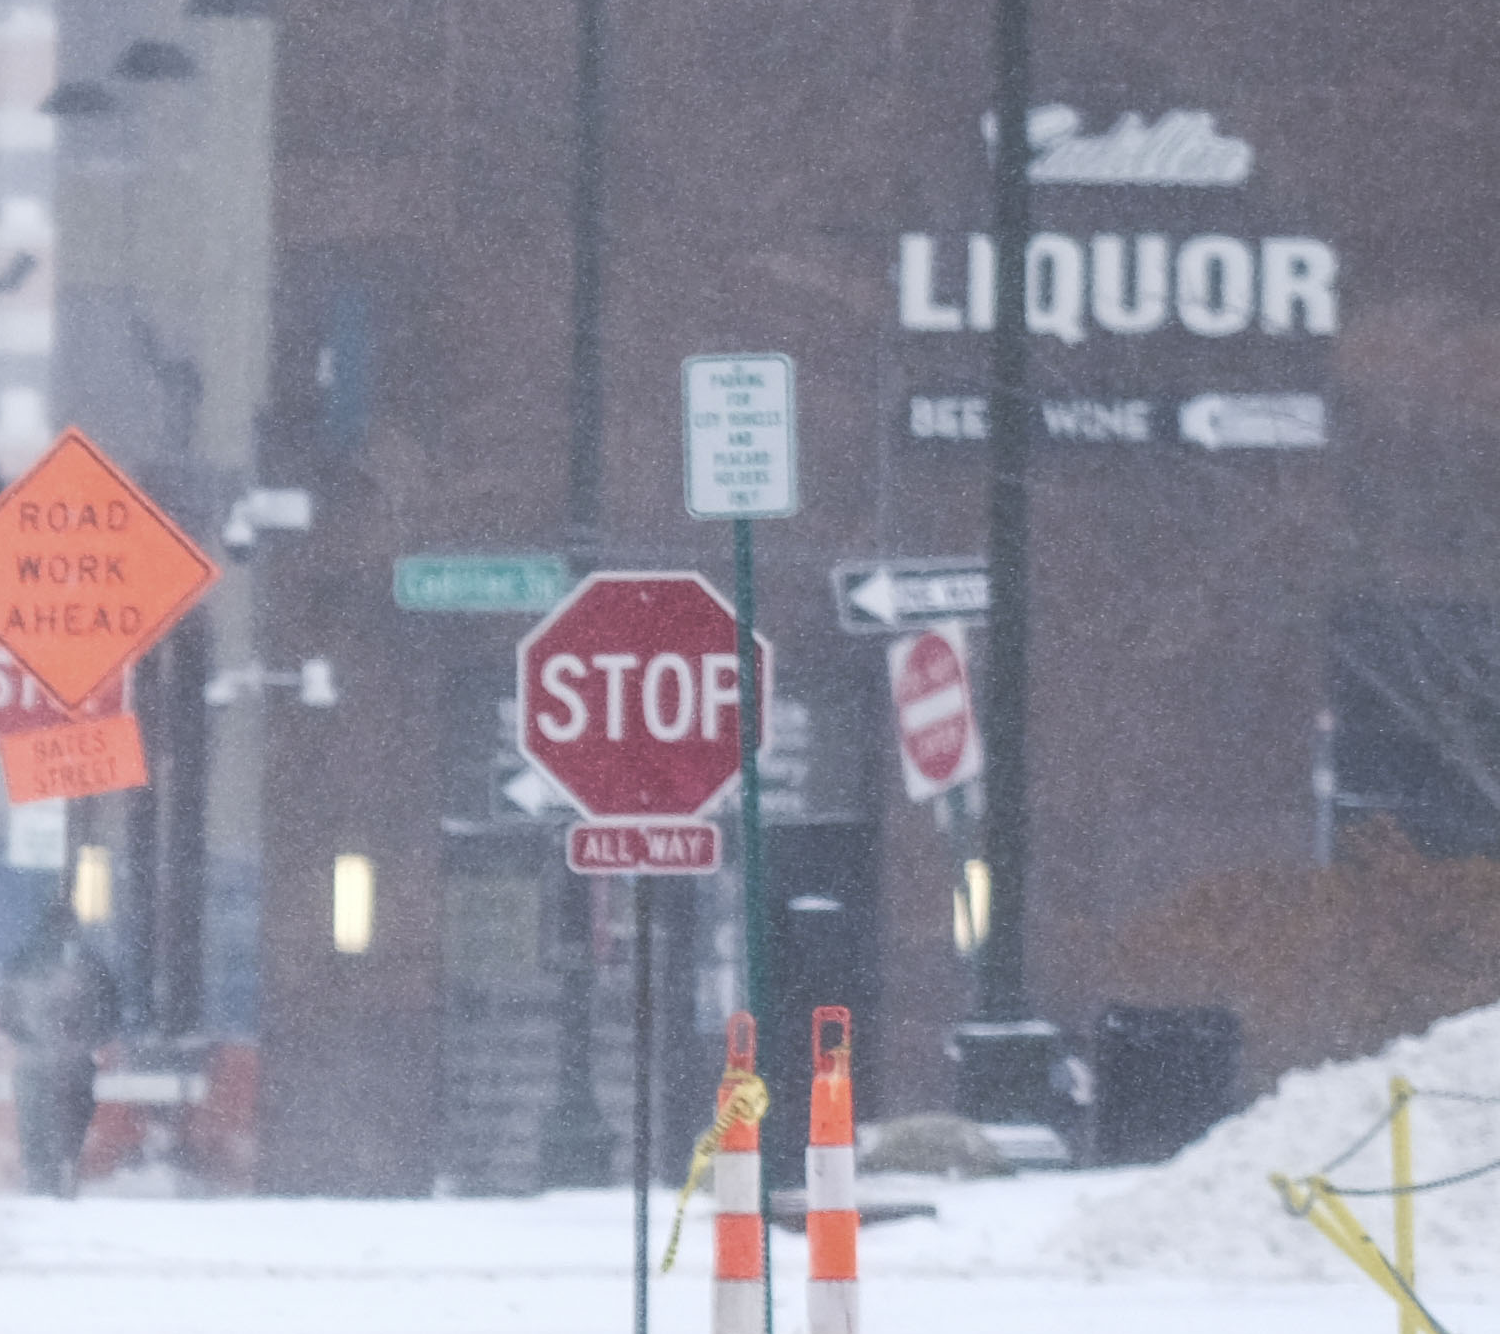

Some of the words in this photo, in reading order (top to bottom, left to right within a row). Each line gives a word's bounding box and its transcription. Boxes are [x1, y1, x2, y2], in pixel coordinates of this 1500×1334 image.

[902, 232, 1339, 345] LIQUOR
[911, 396, 989, 440] BEE
[19, 500, 130, 532] ROAD
[16, 553, 126, 584] WORK
[5, 603, 142, 635] AHEAD
[537, 653, 741, 743] STOP
[33, 729, 108, 759] BATES
[33, 757, 118, 794] STREET
[583, 833, 634, 862] ALL
[649, 831, 702, 861] WAY
